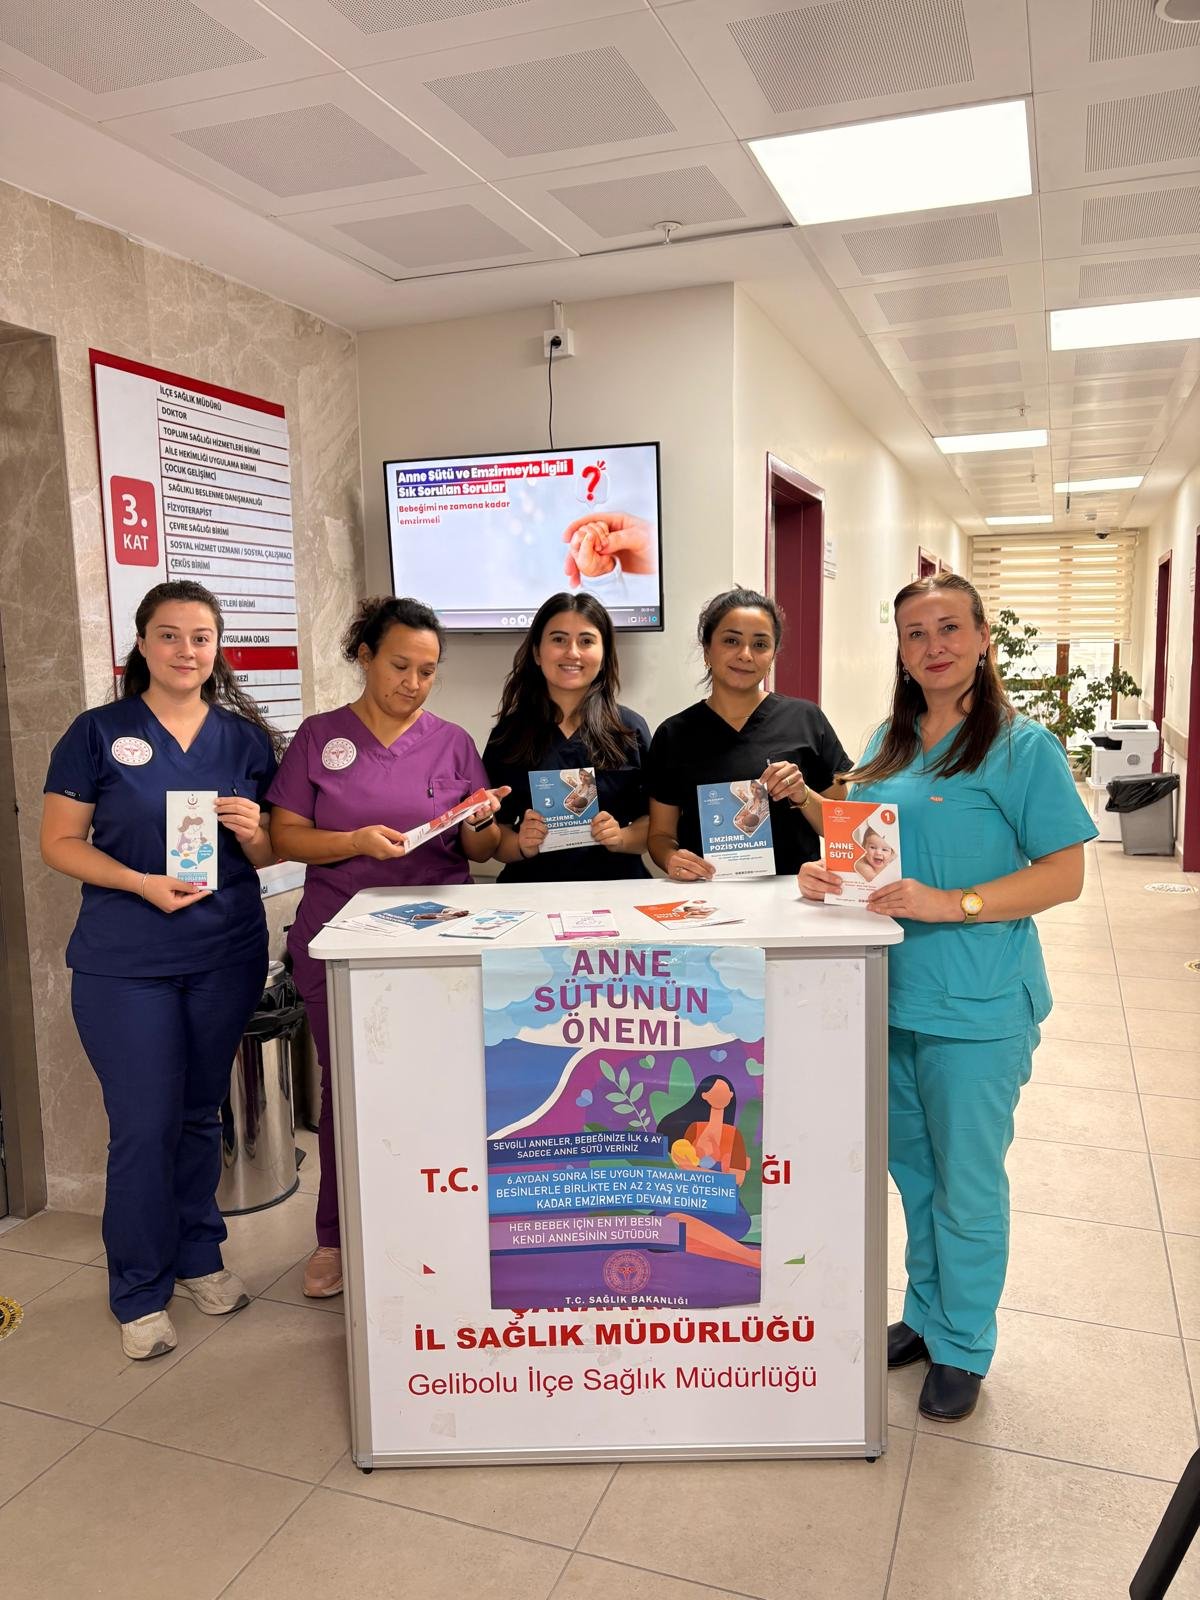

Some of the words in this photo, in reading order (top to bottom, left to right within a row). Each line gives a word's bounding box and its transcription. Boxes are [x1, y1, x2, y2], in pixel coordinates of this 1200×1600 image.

[160, 385, 173, 398] İLÇE
[174, 389, 196, 405] SAĞLIK
[196, 396, 222, 411] MÜDÜRÜ
[161, 406, 188, 420] DOKTOR
[163, 426, 189, 440] TOPLUM
[189, 432, 212, 446] SAĞLIĞI
[212, 438, 244, 453] HİZMETLERİ
[244, 445, 261, 456] BİRİMİ
[164, 445, 178, 457] AİLE
[178, 449, 208, 463] HEKİMLİĞİ
[208, 456, 240, 469] UYGULAMA
[240, 461, 257, 473] BİRİMİ
[164, 463, 187, 475] ÇOCUK
[187, 467, 217, 481] GELİŞİMCİ
[398, 471, 427, 484] Anne
[428, 468, 454, 482] Sütü
[455, 470, 470, 479] ve
[471, 464, 540, 479] Emzirmeyle
[541, 460, 568, 476] İlgili
[168, 483, 195, 495] SAĞLIKLI
[195, 487, 225, 500] BESLENME
[224, 493, 263, 506] DANIŞMANLIĞI
[398, 486, 417, 498] Sık
[417, 484, 461, 497] Sorulan
[462, 482, 506, 495] Sorular
[121, 493, 149, 528] 3.
[167, 502, 213, 517] FİZYOTERAPİST
[399, 502, 437, 514] Bebeğimi
[449, 502, 484, 511] zamana
[485, 499, 511, 509] kadar
[400, 514, 441, 526] emzirmeli
[169, 521, 188, 532] ÇEVRE
[188, 523, 212, 534] SAĞLIĞI
[212, 526, 229, 537] BİRİMİ
[123, 533, 149, 551] KAT
[170, 539, 193, 551] SOSYAL
[194, 541, 217, 552] HİZMET
[217, 545, 241, 555] UZMANI
[244, 548, 264, 558] SOSYAL
[264, 550, 292, 561] ÇALIŞMACI
[170, 557, 191, 570] ÇEKÜS
[191, 559, 210, 571] BİRİMİ
[219, 598, 238, 608] ETLERİ
[238, 599, 256, 609] BİRİMİ
[221, 635, 253, 644] UYGULAMA
[253, 635, 270, 644] ODASI
[544, 796, 552, 807] 2
[545, 818, 592, 829] OZİSYONLAR
[713, 814, 721, 824] 2
[884, 811, 891, 822] 1
[709, 834, 745, 844] EMZİRME
[709, 840, 767, 852] POZİSYONLARI
[829, 841, 855, 850] ANNE
[829, 850, 854, 860] SÜTÜ
[572, 949, 672, 977] ANNE
[534, 977, 708, 1014] SÜTÜNÜN
[562, 1012, 681, 1047] ÖNEMİ
[493, 1140, 527, 1151] SEVGİLİ
[528, 1138, 573, 1148] ANNELER,
[575, 1133, 626, 1145] BEBEĞİNİZE
[627, 1132, 642, 1142] İLK
[643, 1135, 650, 1143] 6
[651, 1136, 662, 1144] AY
[517, 1149, 552, 1159] SADECE
[553, 1147, 578, 1156] ANNE
[580, 1144, 603, 1154] SÜTÜ
[604, 1143, 639, 1153] VERİNİZ
[420, 1167, 479, 1193] T.C.
[552, 1171, 588, 1182] SONRA
[590, 1169, 607, 1180] İSE
[609, 1169, 644, 1179] UYGUN
[646, 1169, 715, 1184] TAMAMLAYICI
[496, 1185, 561, 1198] BESİNLERLE
[564, 1181, 610, 1194] BİRLİKTE
[613, 1182, 627, 1191] EN
[630, 1181, 643, 1191] AZ
[646, 1182, 652, 1191] 2
[654, 1182, 673, 1194] YAŞ
[676, 1184, 689, 1194] VE
[692, 1184, 736, 1198] ÖTESİNE
[536, 1199, 572, 1209] KADAR
[575, 1194, 633, 1207] EMZİRMEYE
[636, 1194, 671, 1205] DEVAM
[674, 1196, 708, 1209] EDİNİZ
[509, 1222, 531, 1232] HER
[534, 1219, 570, 1231] BEBEK
[573, 1217, 594, 1230] İÇİN
[597, 1217, 612, 1228] EN
[615, 1216, 627, 1227] İYİ
[630, 1216, 662, 1228] BESİN
[512, 1232, 545, 1245] KENDİ
[548, 1230, 607, 1243] ANNESİNİN
[610, 1229, 660, 1240] SÜTÜDÜR
[565, 1296, 585, 1305] T.C.
[589, 1294, 628, 1304] SAĞLIK
[631, 1295, 688, 1305] BAKANLIĞI
[414, 1324, 446, 1351] İL
[456, 1320, 584, 1349] SAĞLIK
[595, 1315, 815, 1345] MÜDÜRLÜĞÜ
[408, 1371, 518, 1396] Gelibolu
[528, 1366, 574, 1398] İlçe
[583, 1368, 666, 1396] Sağlık
[676, 1365, 817, 1393] Müdürlüğü
